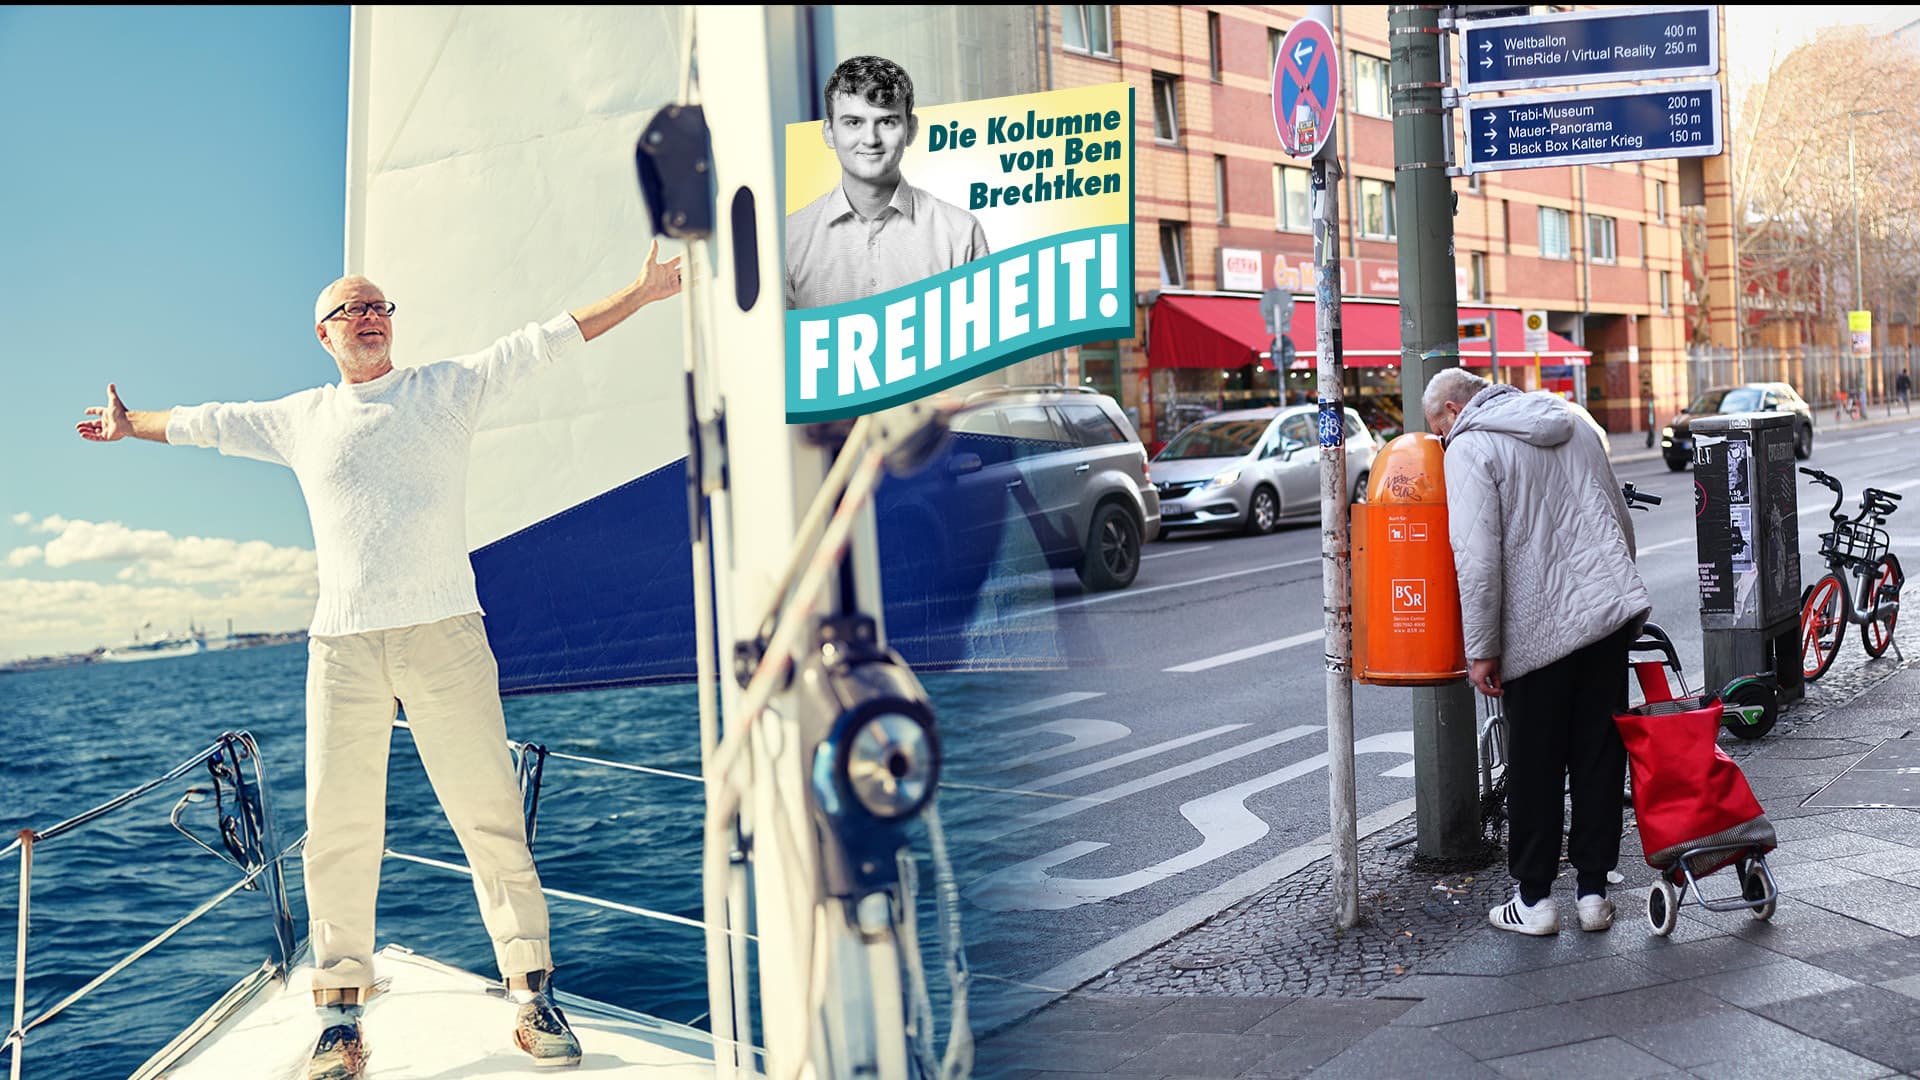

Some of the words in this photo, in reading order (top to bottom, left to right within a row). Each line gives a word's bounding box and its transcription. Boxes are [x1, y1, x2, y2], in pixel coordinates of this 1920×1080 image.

[1664, 25, 1684, 38] 400
[1687, 26, 1697, 36] m
[1504, 35, 1567, 50] Weltballon
[1665, 41, 1685, 55] 250
[1687, 43, 1697, 53] m
[1505, 51, 1561, 67] TimeRide
[1572, 47, 1610, 61] Virtual
[1614, 44, 1656, 59] Reality
[1667, 96, 1687, 109] 200
[1690, 97, 1700, 107] m
[1508, 106, 1594, 122] Trabi-Museum
[1669, 113, 1688, 126] 150
[1691, 114, 1701, 124] m
[1509, 121, 1613, 138] Mauer-Panorama
[1670, 130, 1689, 143] 150
[1691, 131, 1701, 141] m
[1509, 141, 1542, 155] Black
[1545, 140, 1569, 152] Box
[1572, 137, 1607, 150] Kalter
[1611, 134, 1643, 148] Krieg
[1395, 585, 1422, 607] BSR
